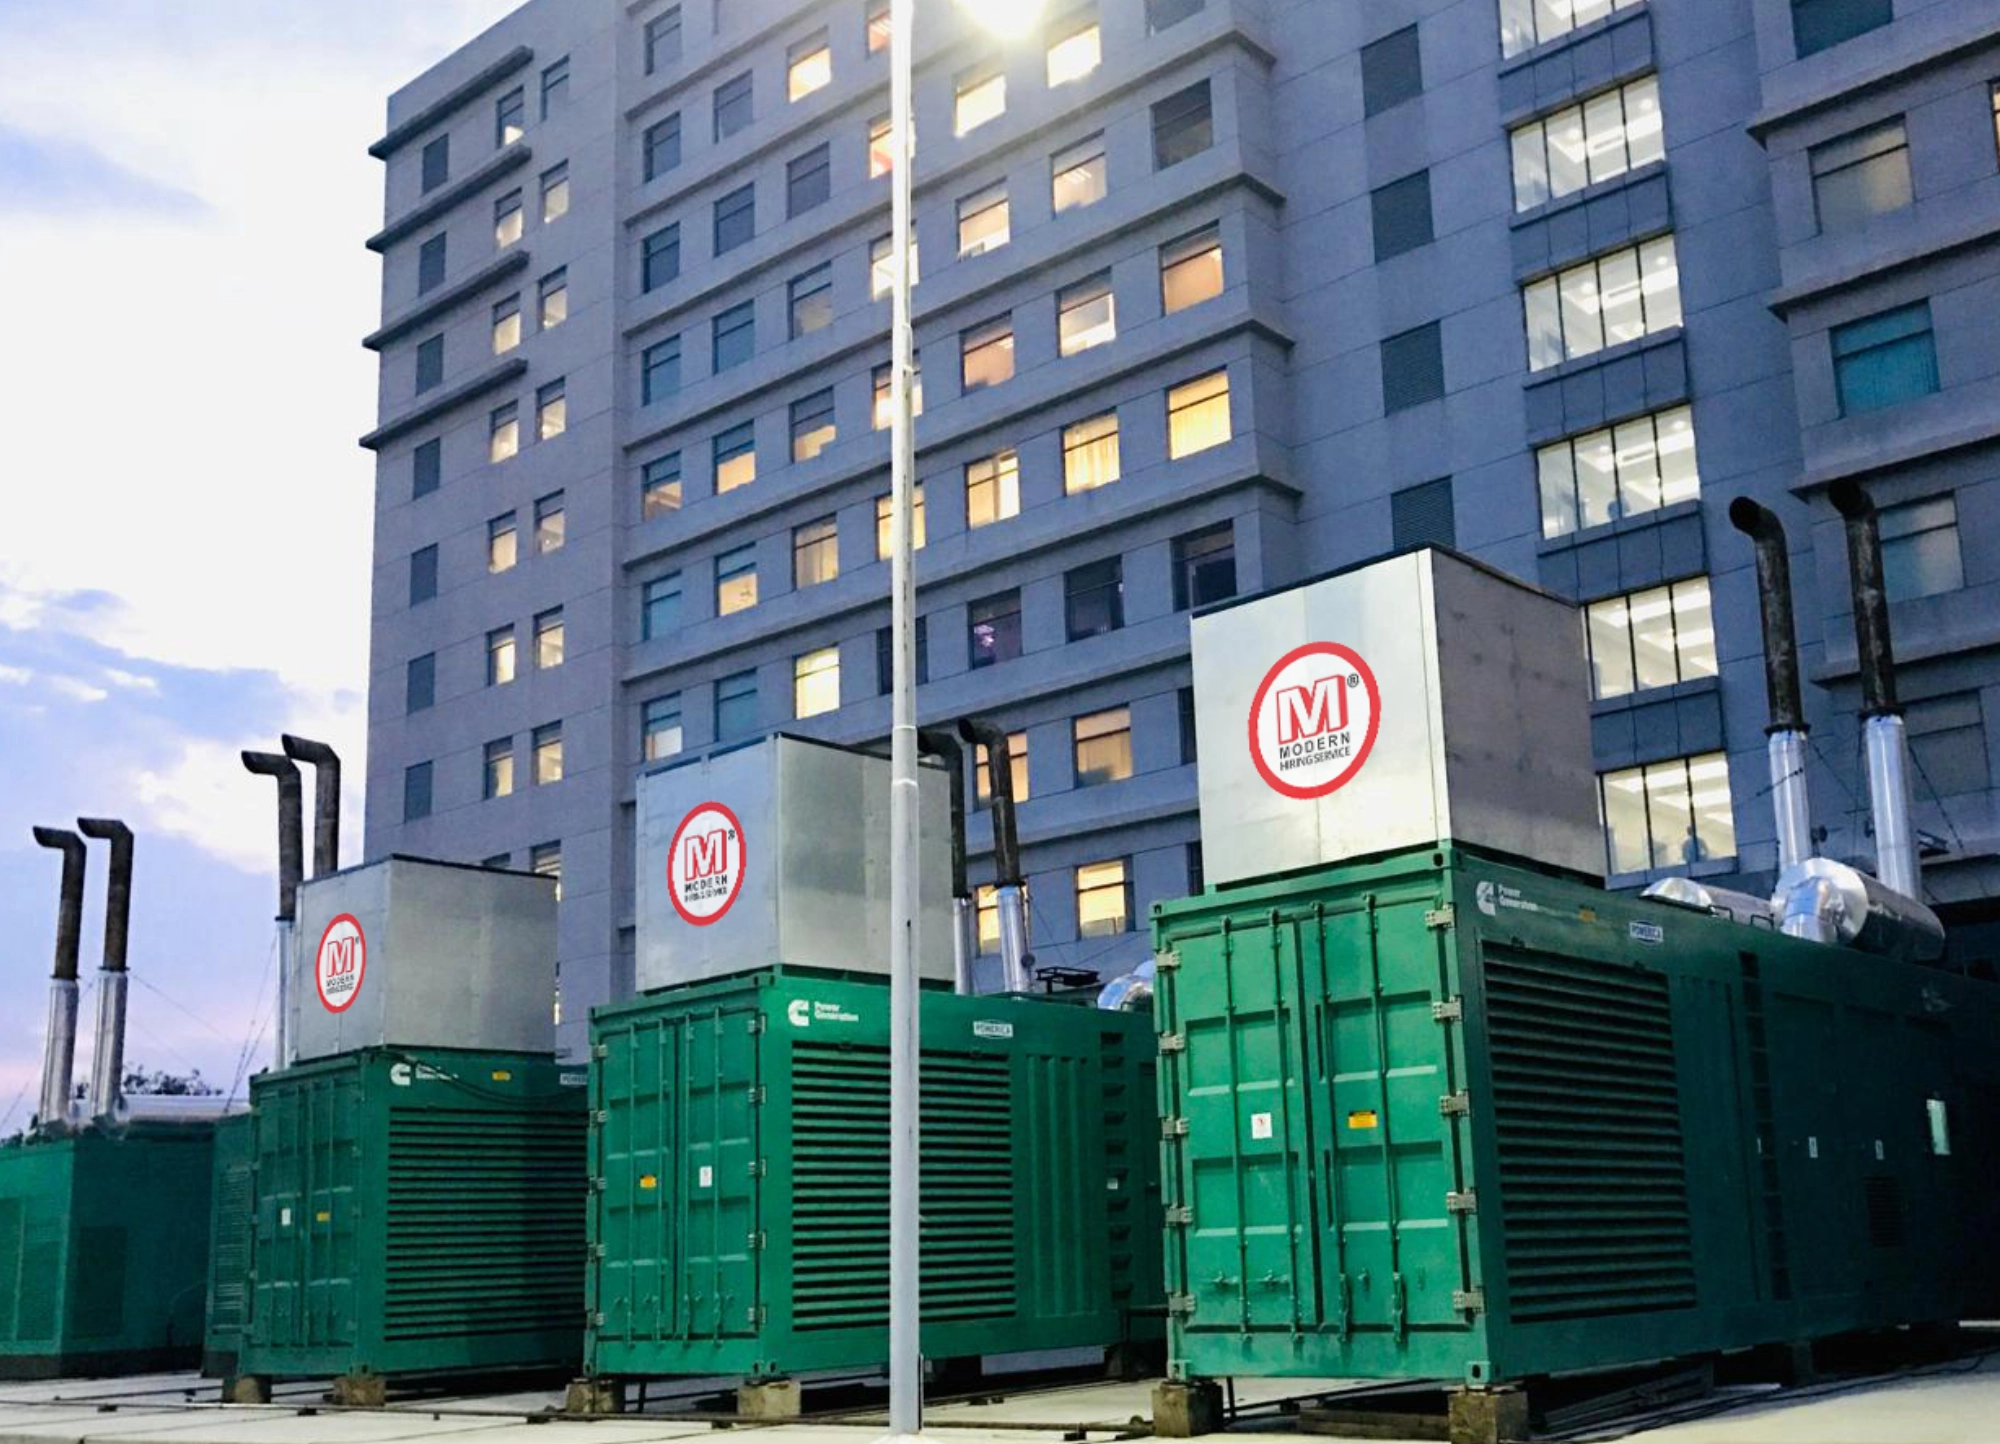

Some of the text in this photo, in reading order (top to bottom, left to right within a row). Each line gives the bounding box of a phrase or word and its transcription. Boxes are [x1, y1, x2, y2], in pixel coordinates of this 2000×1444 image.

[1276, 674, 1349, 745] M
[1279, 731, 1351, 759] MODERN
[684, 828, 727, 881] M
